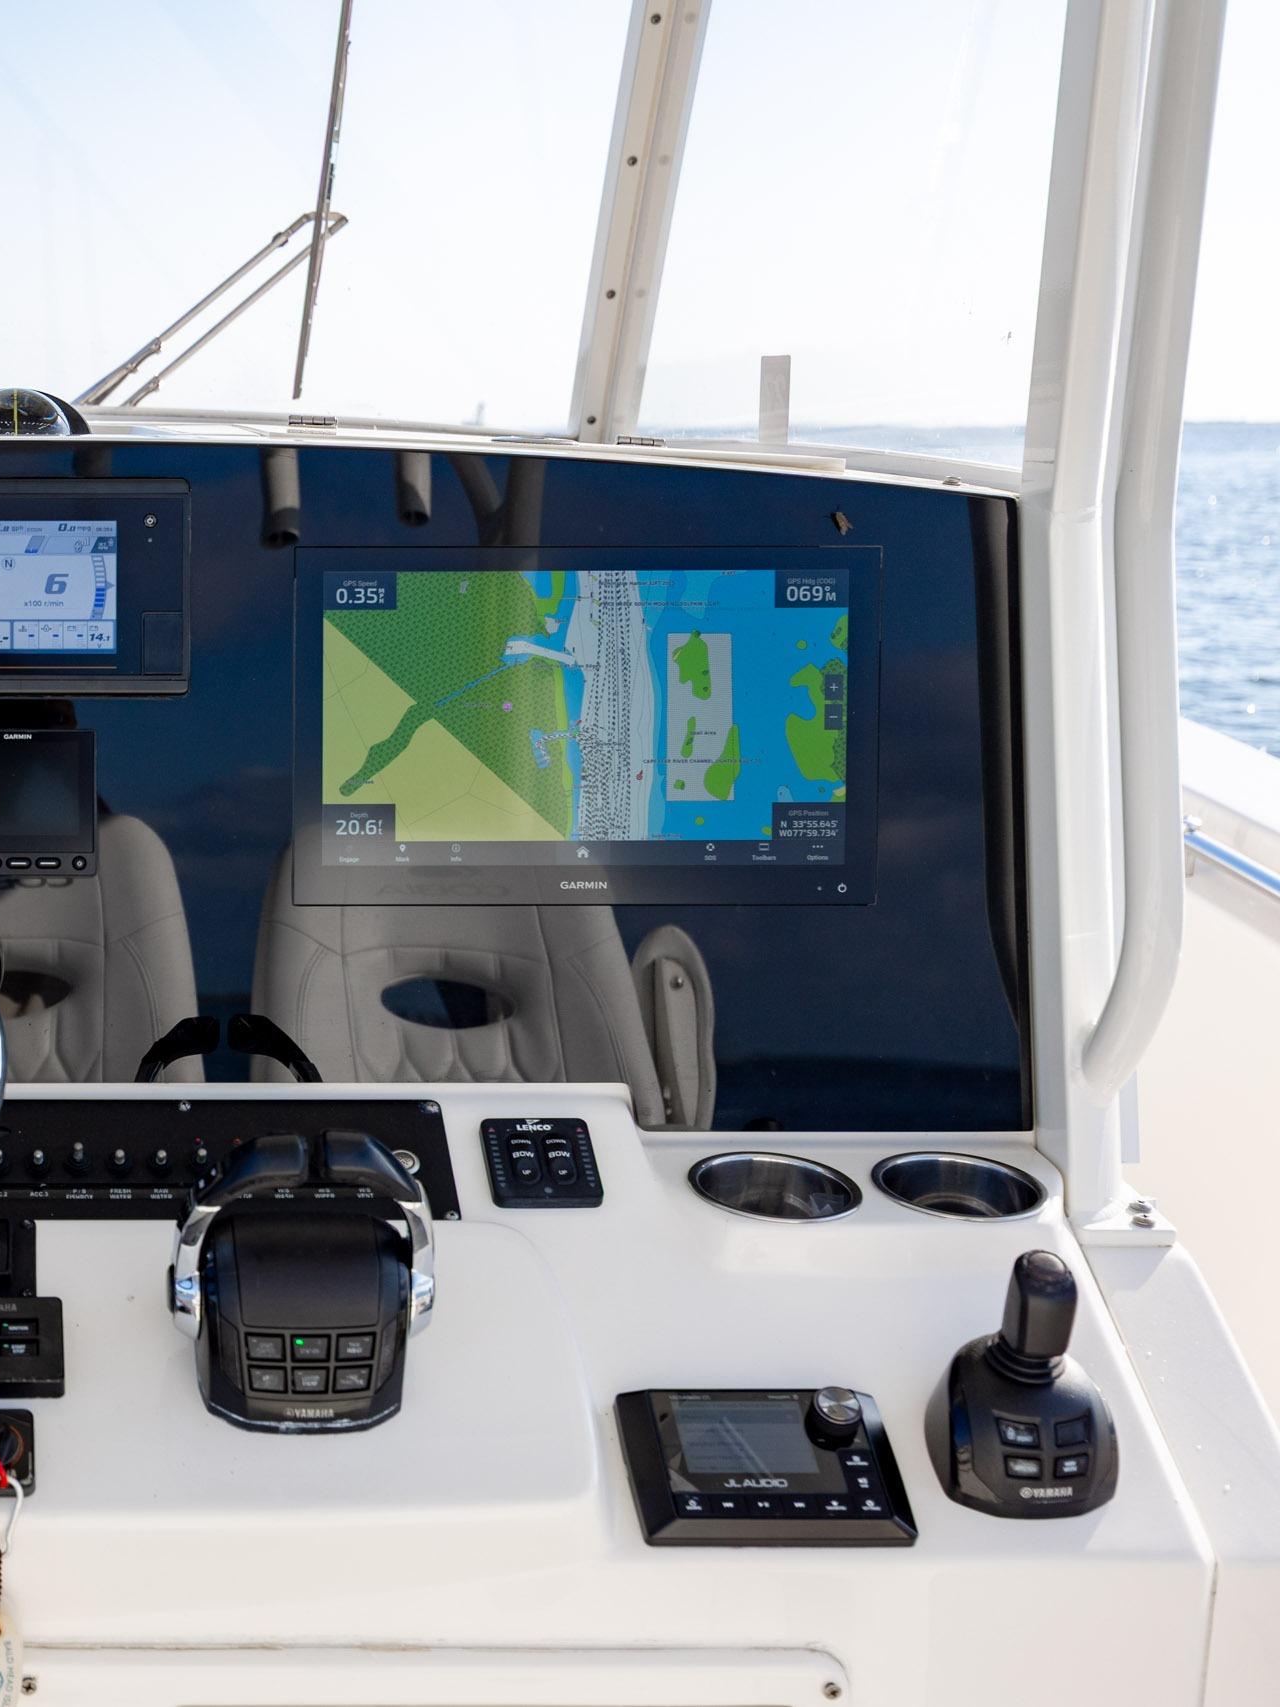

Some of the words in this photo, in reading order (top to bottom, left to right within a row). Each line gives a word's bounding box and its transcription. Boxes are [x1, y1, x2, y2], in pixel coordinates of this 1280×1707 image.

[45, 574, 69, 594] 6
[336, 588, 378, 604] 0.35
[336, 820, 376, 835] 20.6
[560, 881, 608, 890] GARMIN
[295, 1409, 334, 1417] YAMAHA
[724, 1479, 741, 1488] JL
[742, 1479, 788, 1488] AUDIO
[1033, 1487, 1072, 1497] YAMAHA
